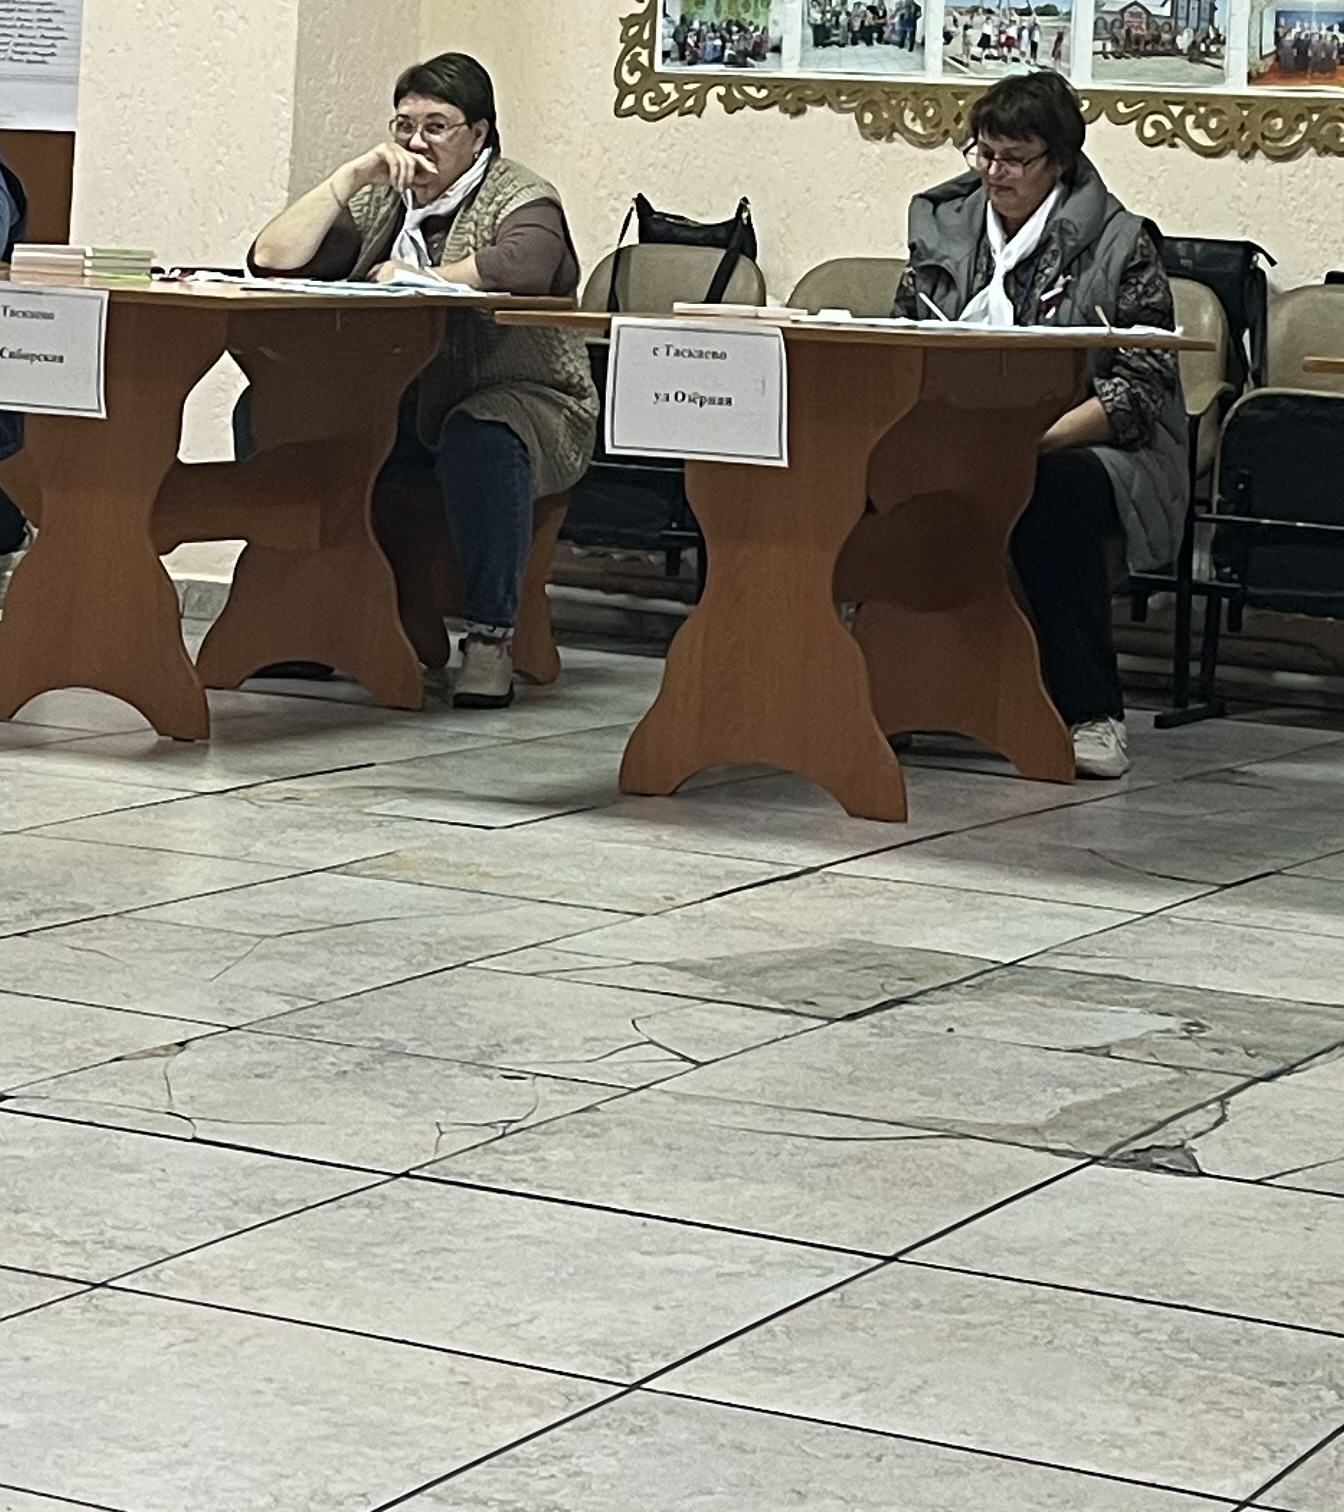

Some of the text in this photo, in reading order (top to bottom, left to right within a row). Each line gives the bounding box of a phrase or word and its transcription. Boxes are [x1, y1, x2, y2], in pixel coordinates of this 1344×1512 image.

[1, 304, 55, 321] Таскаево
[0, 346, 65, 365] Сибирская
[652, 343, 728, 361] с Таскаево
[653, 390, 670, 406] ул
